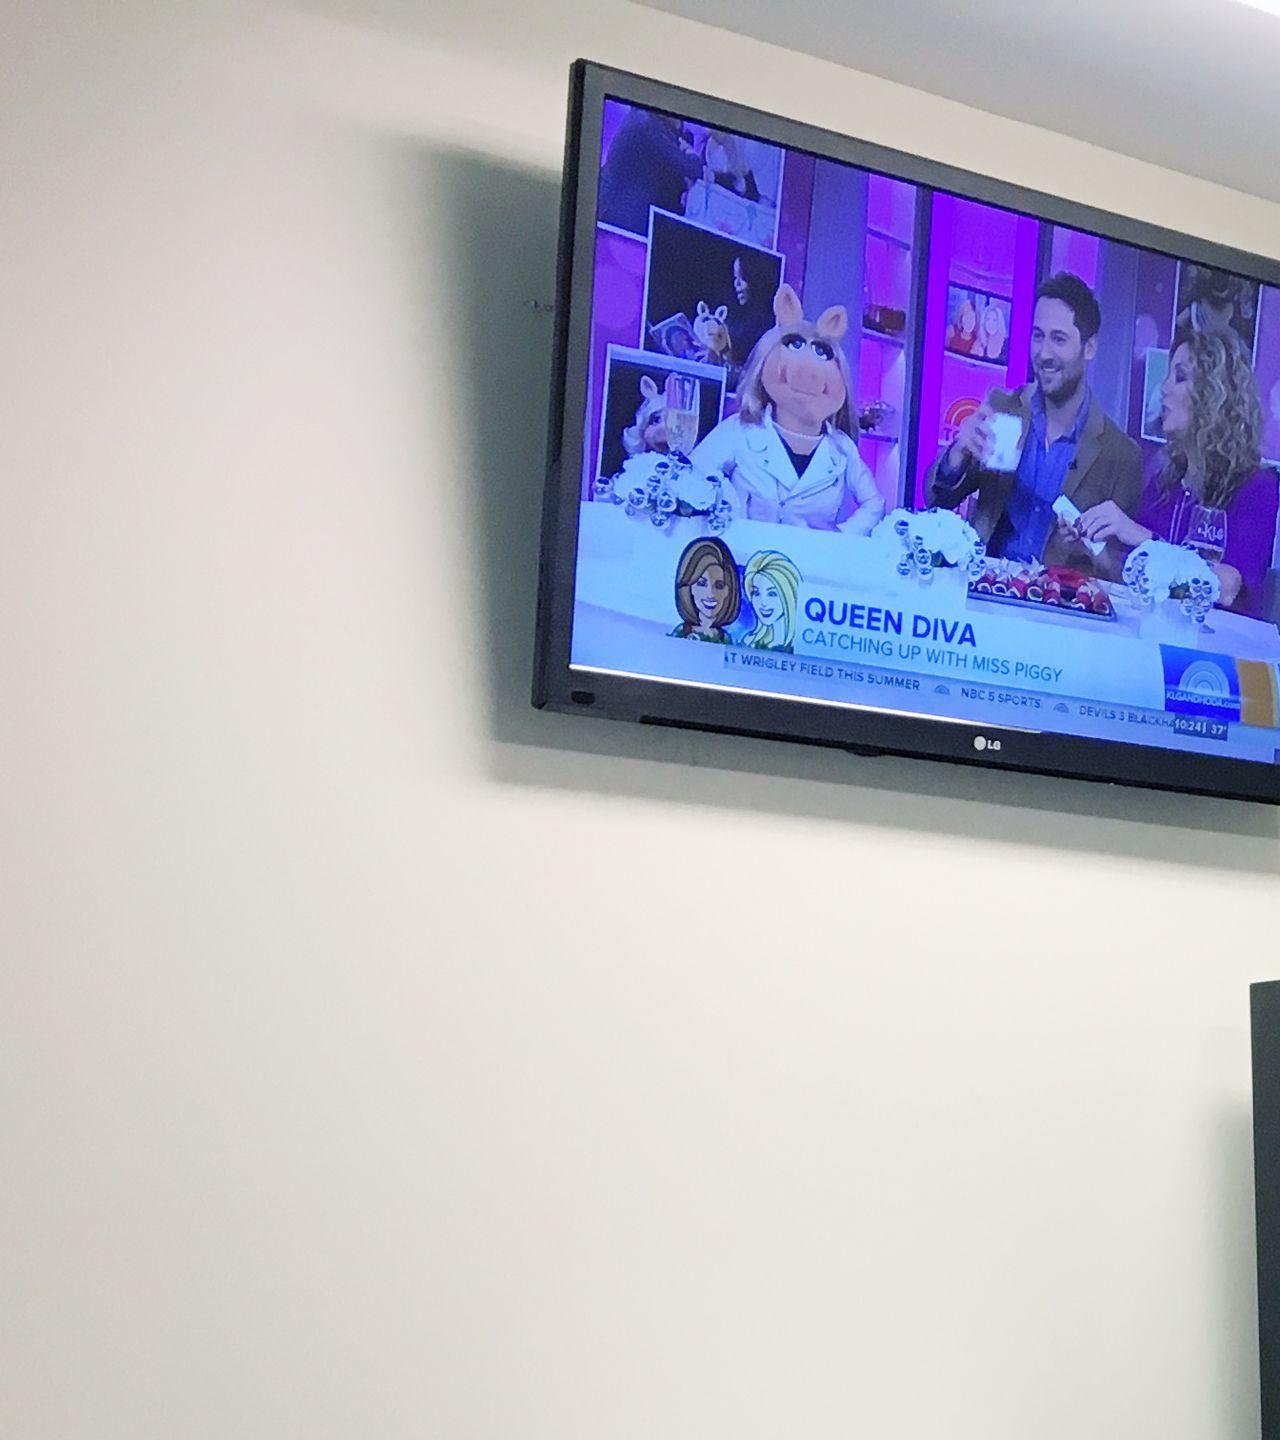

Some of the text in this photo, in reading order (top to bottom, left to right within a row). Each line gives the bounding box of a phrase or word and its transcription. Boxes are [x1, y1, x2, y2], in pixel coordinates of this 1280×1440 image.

[804, 597, 977, 648] QUEEN DIVA
[801, 628, 1063, 683] CATCHING UP WITH MISS PIGGY
[741, 655, 796, 672] WRIGLEY
[800, 663, 834, 678] FIELD
[837, 668, 864, 682] THIS
[868, 674, 920, 691] SUMMER
[961, 687, 1041, 709] NBC 5 SPORTS
[1079, 705, 1116, 720] DEVILS
[987, 739, 1001, 750] LG
